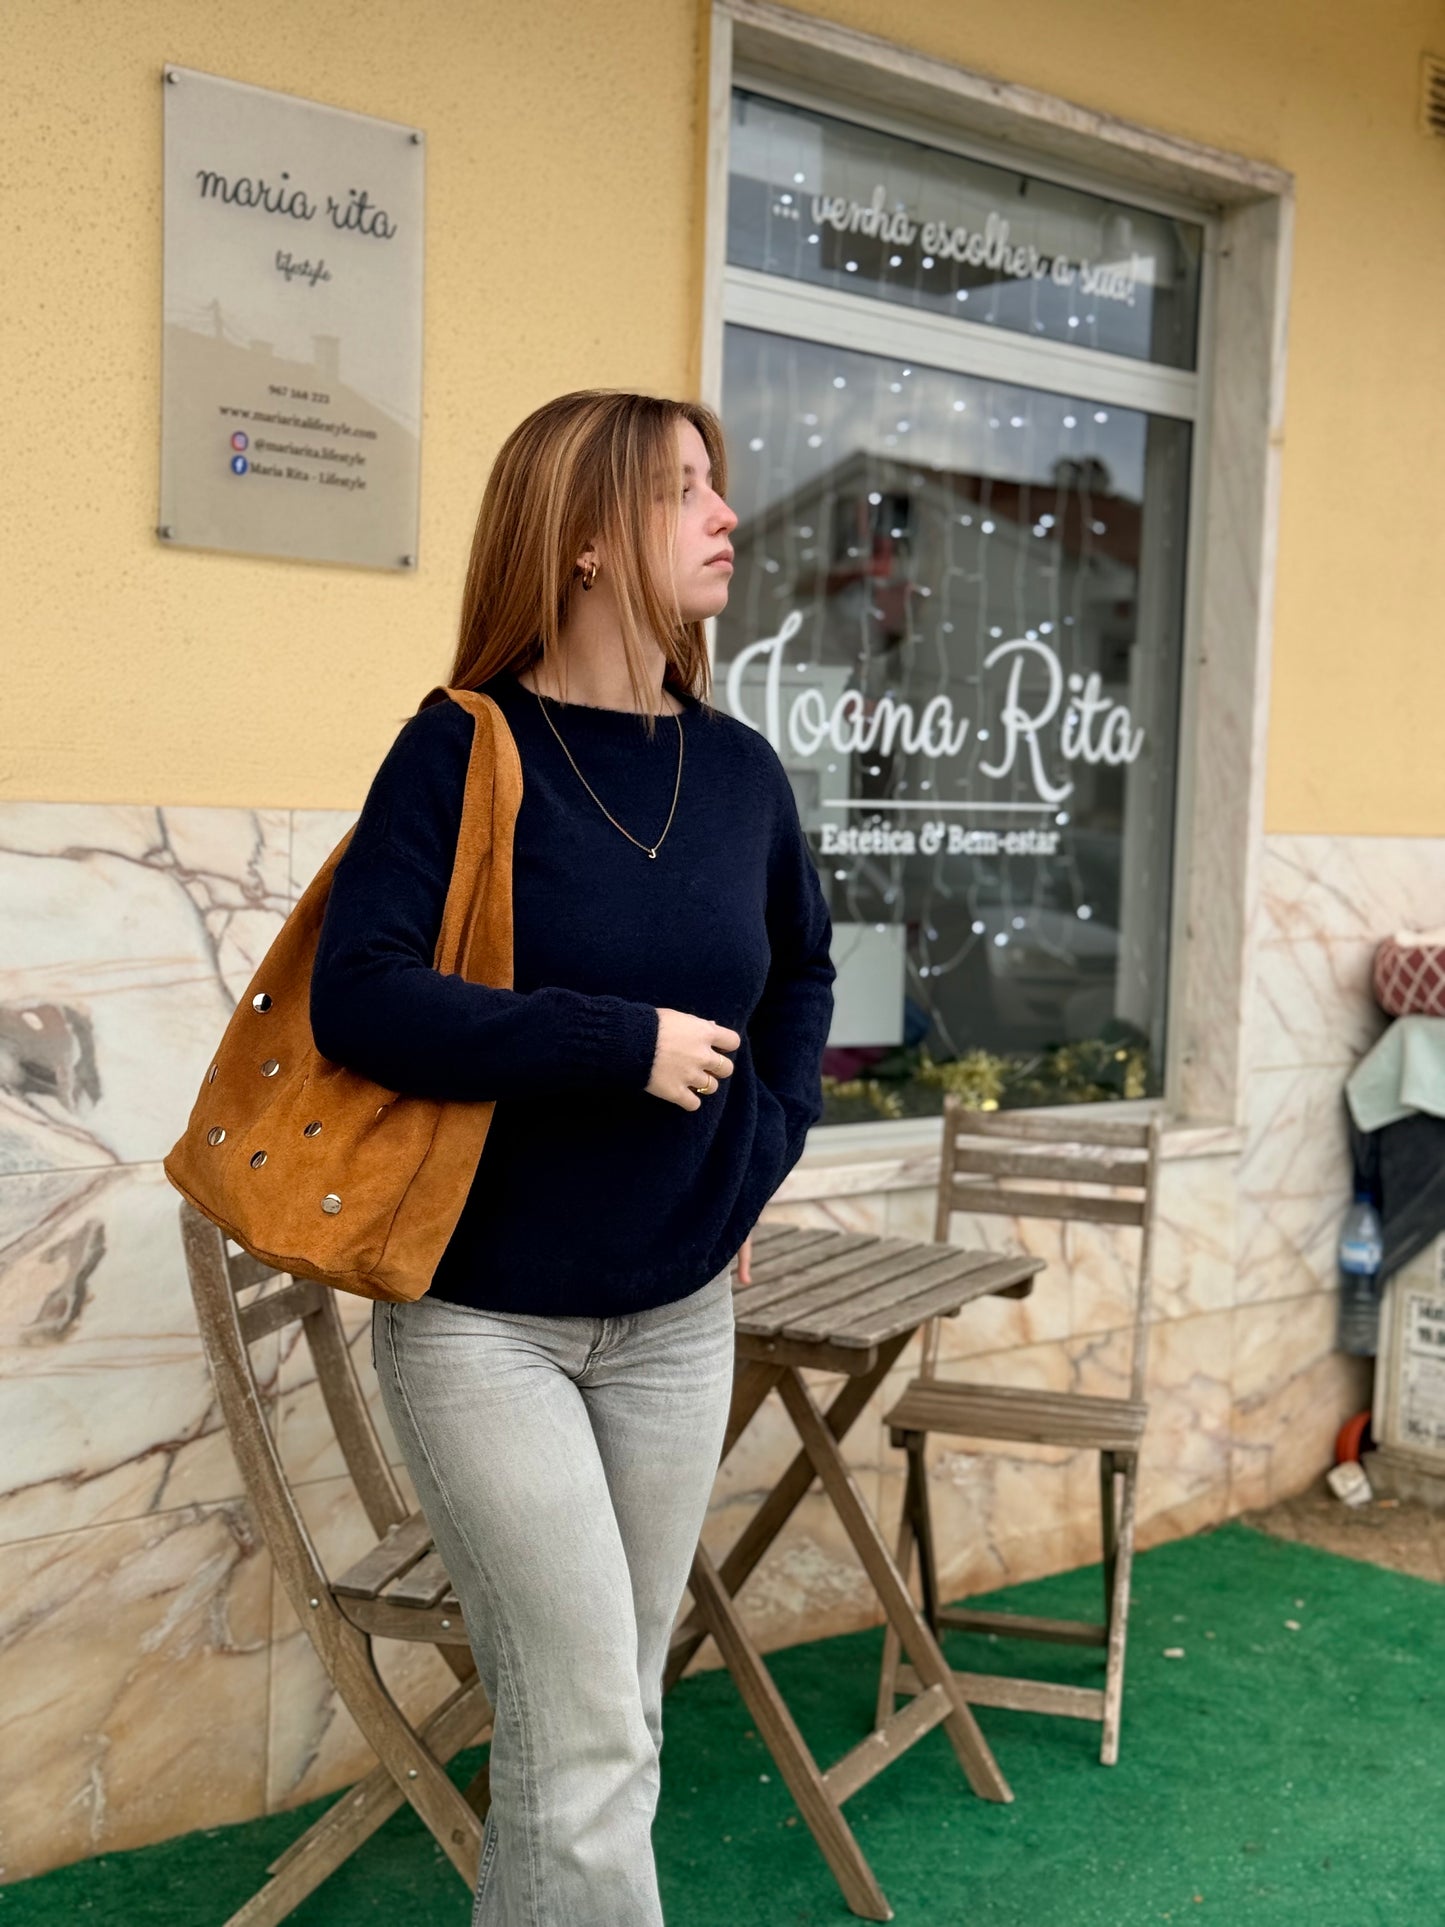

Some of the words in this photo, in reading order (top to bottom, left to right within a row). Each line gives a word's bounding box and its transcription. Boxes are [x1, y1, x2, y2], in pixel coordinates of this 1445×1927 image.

[196, 169, 317, 220] maria
[326, 187, 397, 239] rita
[811, 184, 917, 246] venha
[920, 211, 1048, 281] escolher
[1050, 254, 1077, 287] a
[219, 405, 377, 440] www.mariaritalifestyle.com
[249, 462, 284, 479] Maria
[285, 467, 310, 482] Rita
[318, 472, 366, 492] Lifestyle
[727, 610, 970, 759] Joana
[979, 638, 1145, 803] Rita
[820, 820, 916, 855] Estética
[919, 821, 945, 855] &
[946, 829, 1060, 856] Bem-estar
